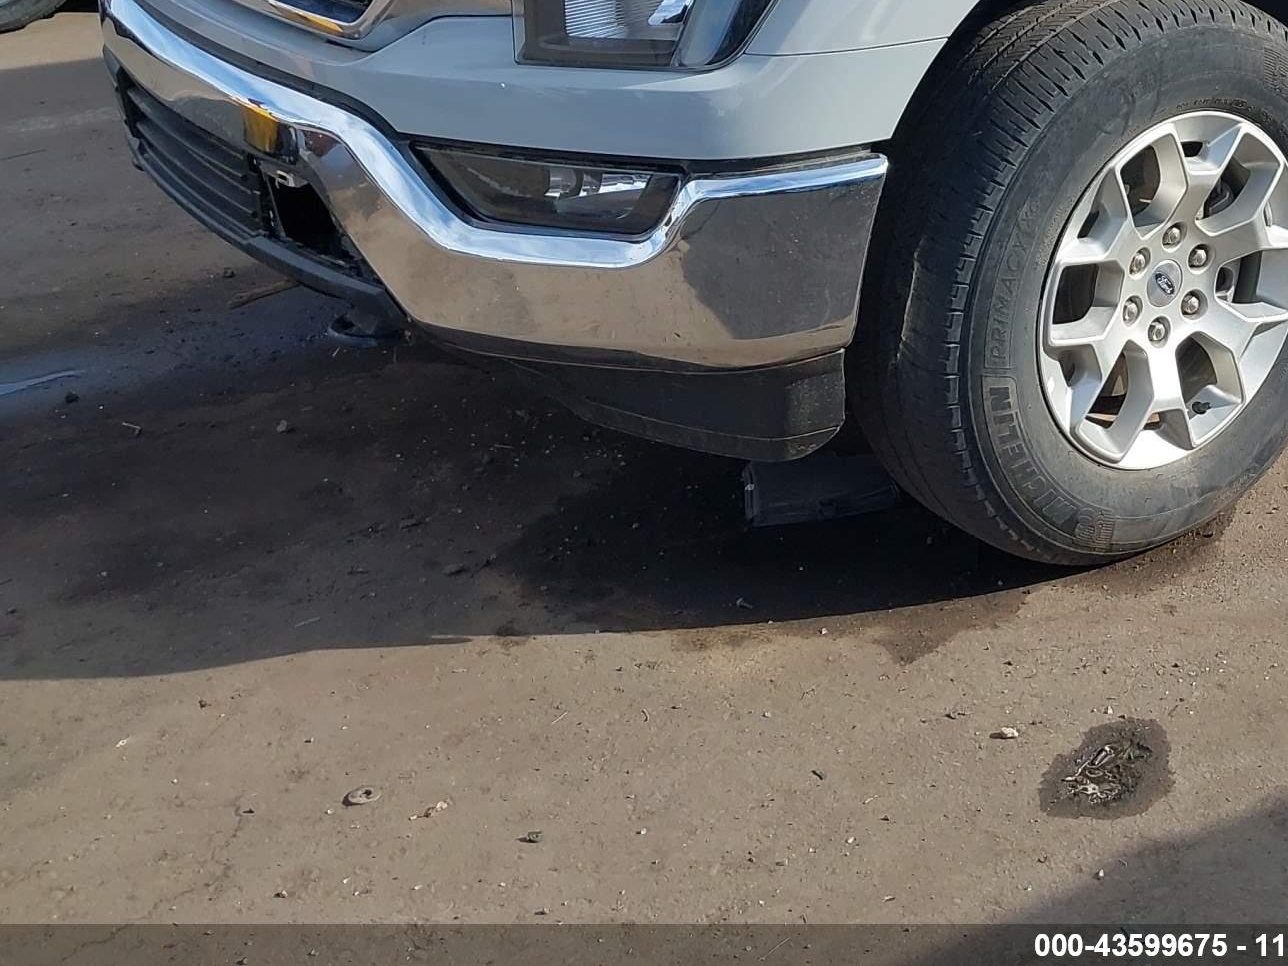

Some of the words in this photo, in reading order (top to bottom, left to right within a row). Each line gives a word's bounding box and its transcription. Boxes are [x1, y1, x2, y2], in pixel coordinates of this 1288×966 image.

[990, 236, 1028, 359] PRIMACY
[1156, 275, 1173, 294] Ford
[989, 386, 1077, 525] MICHELIN
